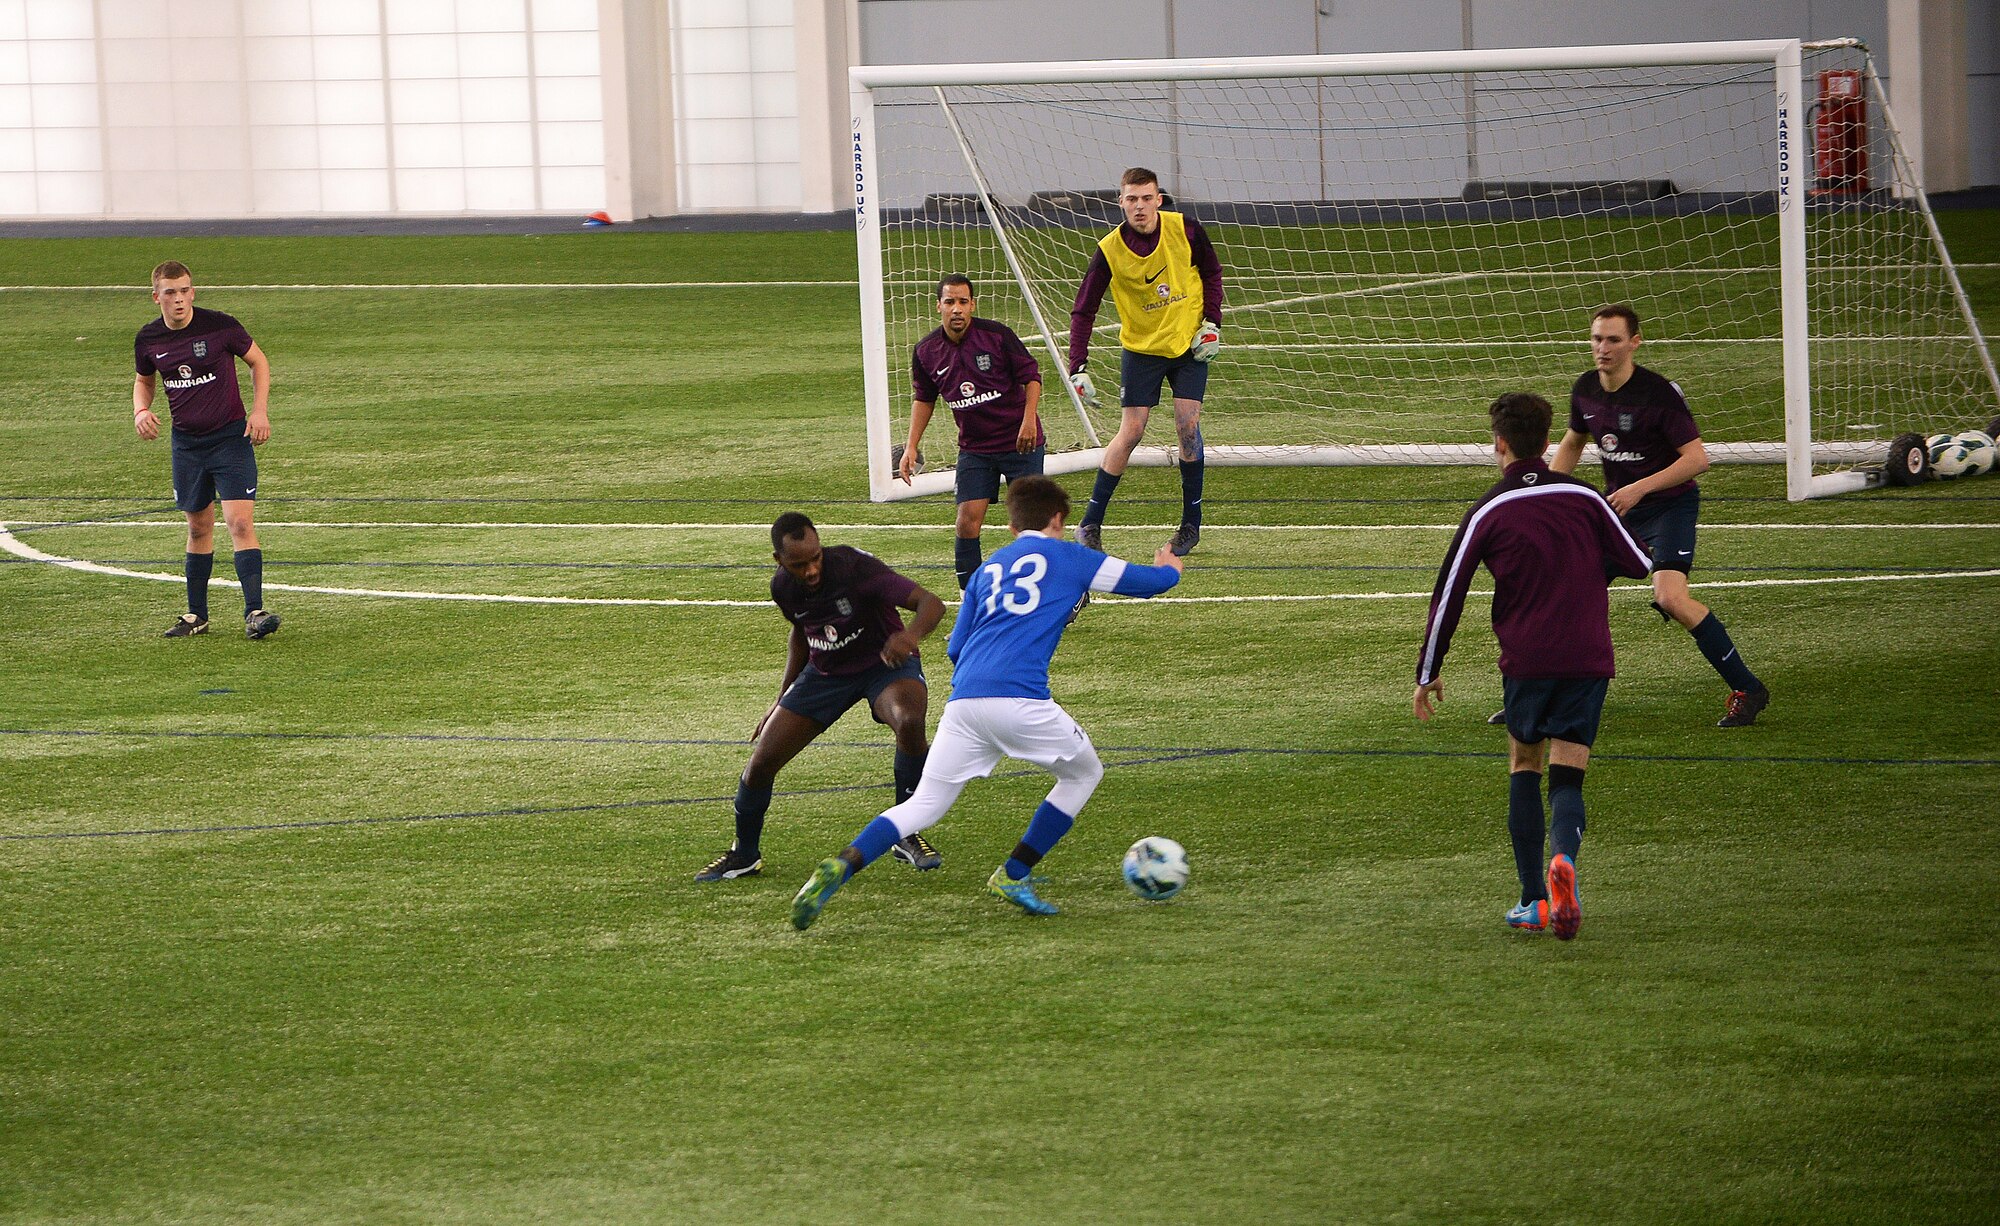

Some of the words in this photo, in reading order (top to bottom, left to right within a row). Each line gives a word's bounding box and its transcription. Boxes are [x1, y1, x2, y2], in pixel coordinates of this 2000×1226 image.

[1779, 109, 1788, 172] HARROD
[853, 132, 863, 192] HARROD
[1780, 177, 1789, 196] UK
[857, 196, 864, 215] UK
[163, 372, 217, 389] VAUXHALL
[946, 390, 1002, 409] VAUXHALL
[983, 552, 1048, 616] 13
